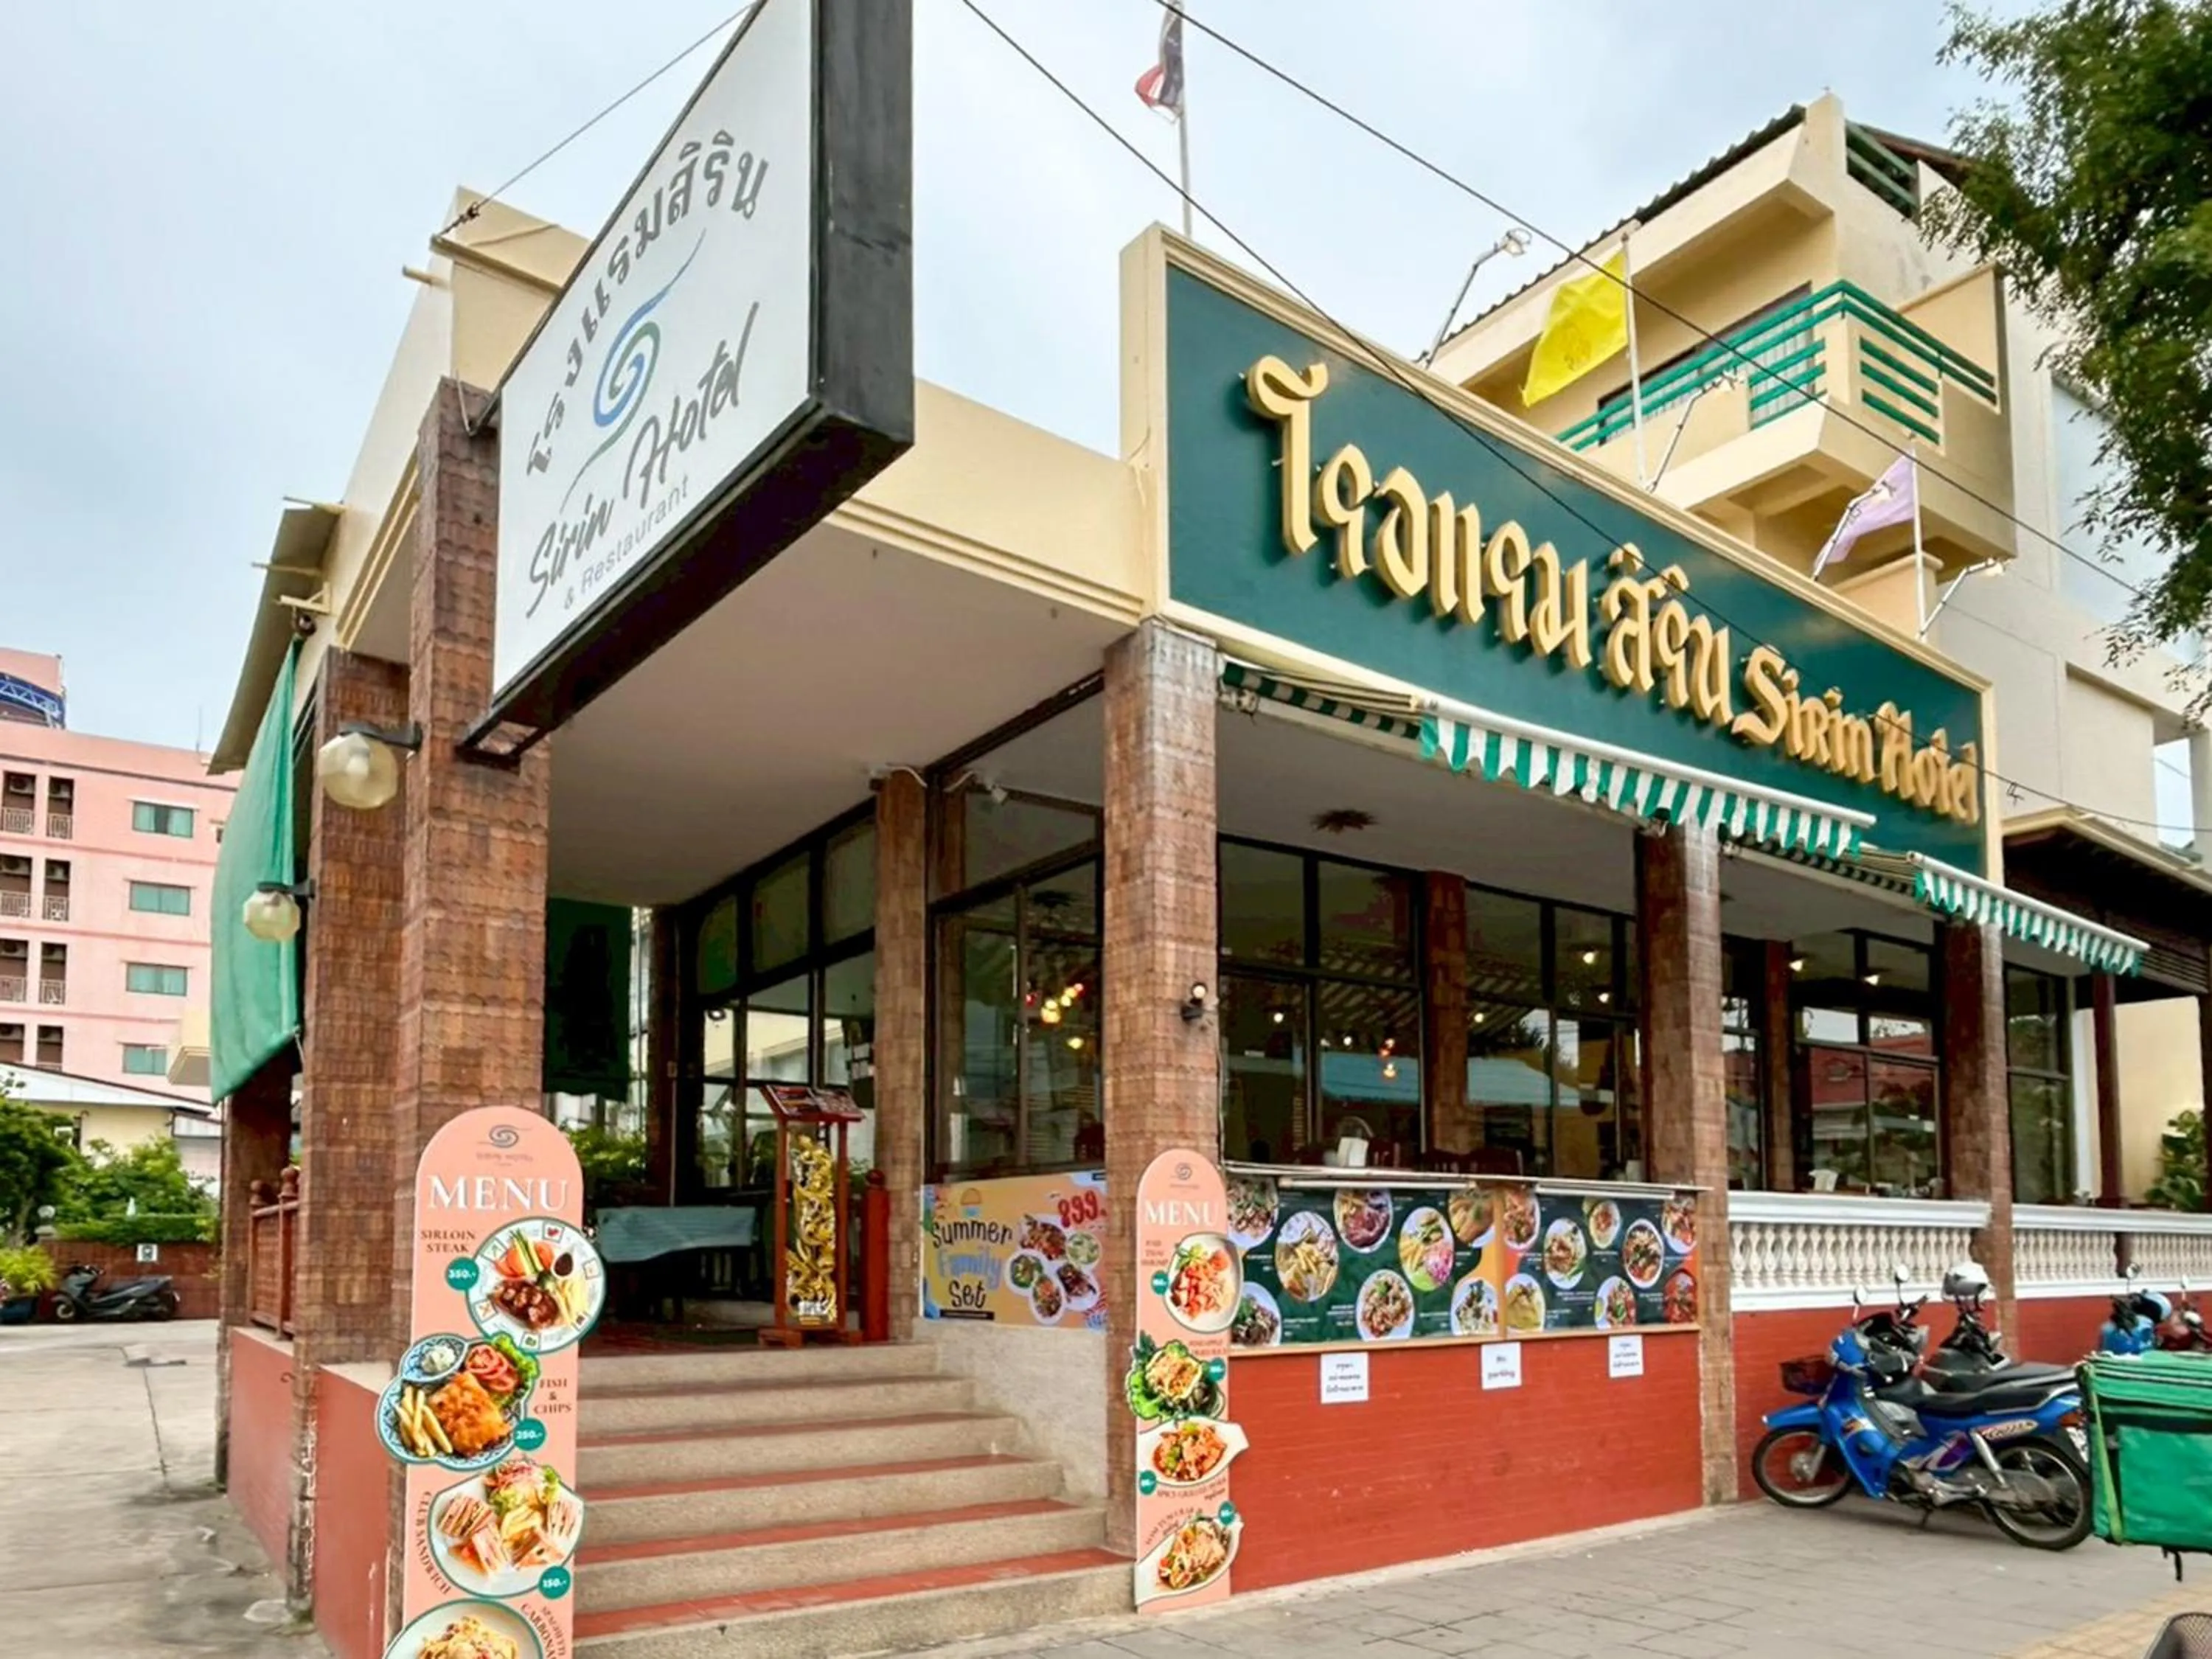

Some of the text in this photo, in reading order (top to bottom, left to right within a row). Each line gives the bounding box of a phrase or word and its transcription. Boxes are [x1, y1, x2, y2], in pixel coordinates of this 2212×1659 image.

[526, 129, 769, 476] โรงแรมสิริน
[526, 301, 759, 619] Sirin Hotel
[563, 473, 691, 610] & Restaurant
[1874, 700, 1980, 825] Hotel
[427, 1175, 568, 1212] MENU
[1144, 1199, 1220, 1227] MENU
[420, 1229, 477, 1241] SIRLOIN
[425, 1242, 470, 1253] STEAK
[931, 1220, 1013, 1249] Summer
[937, 1245, 1002, 1291] Family
[948, 1279, 987, 1309] Set
[539, 1378, 568, 1388] FISH
[549, 1391, 557, 1401] &
[533, 1403, 572, 1414] CHIPS
[416, 1491, 452, 1595] CLUB SANDWICH
